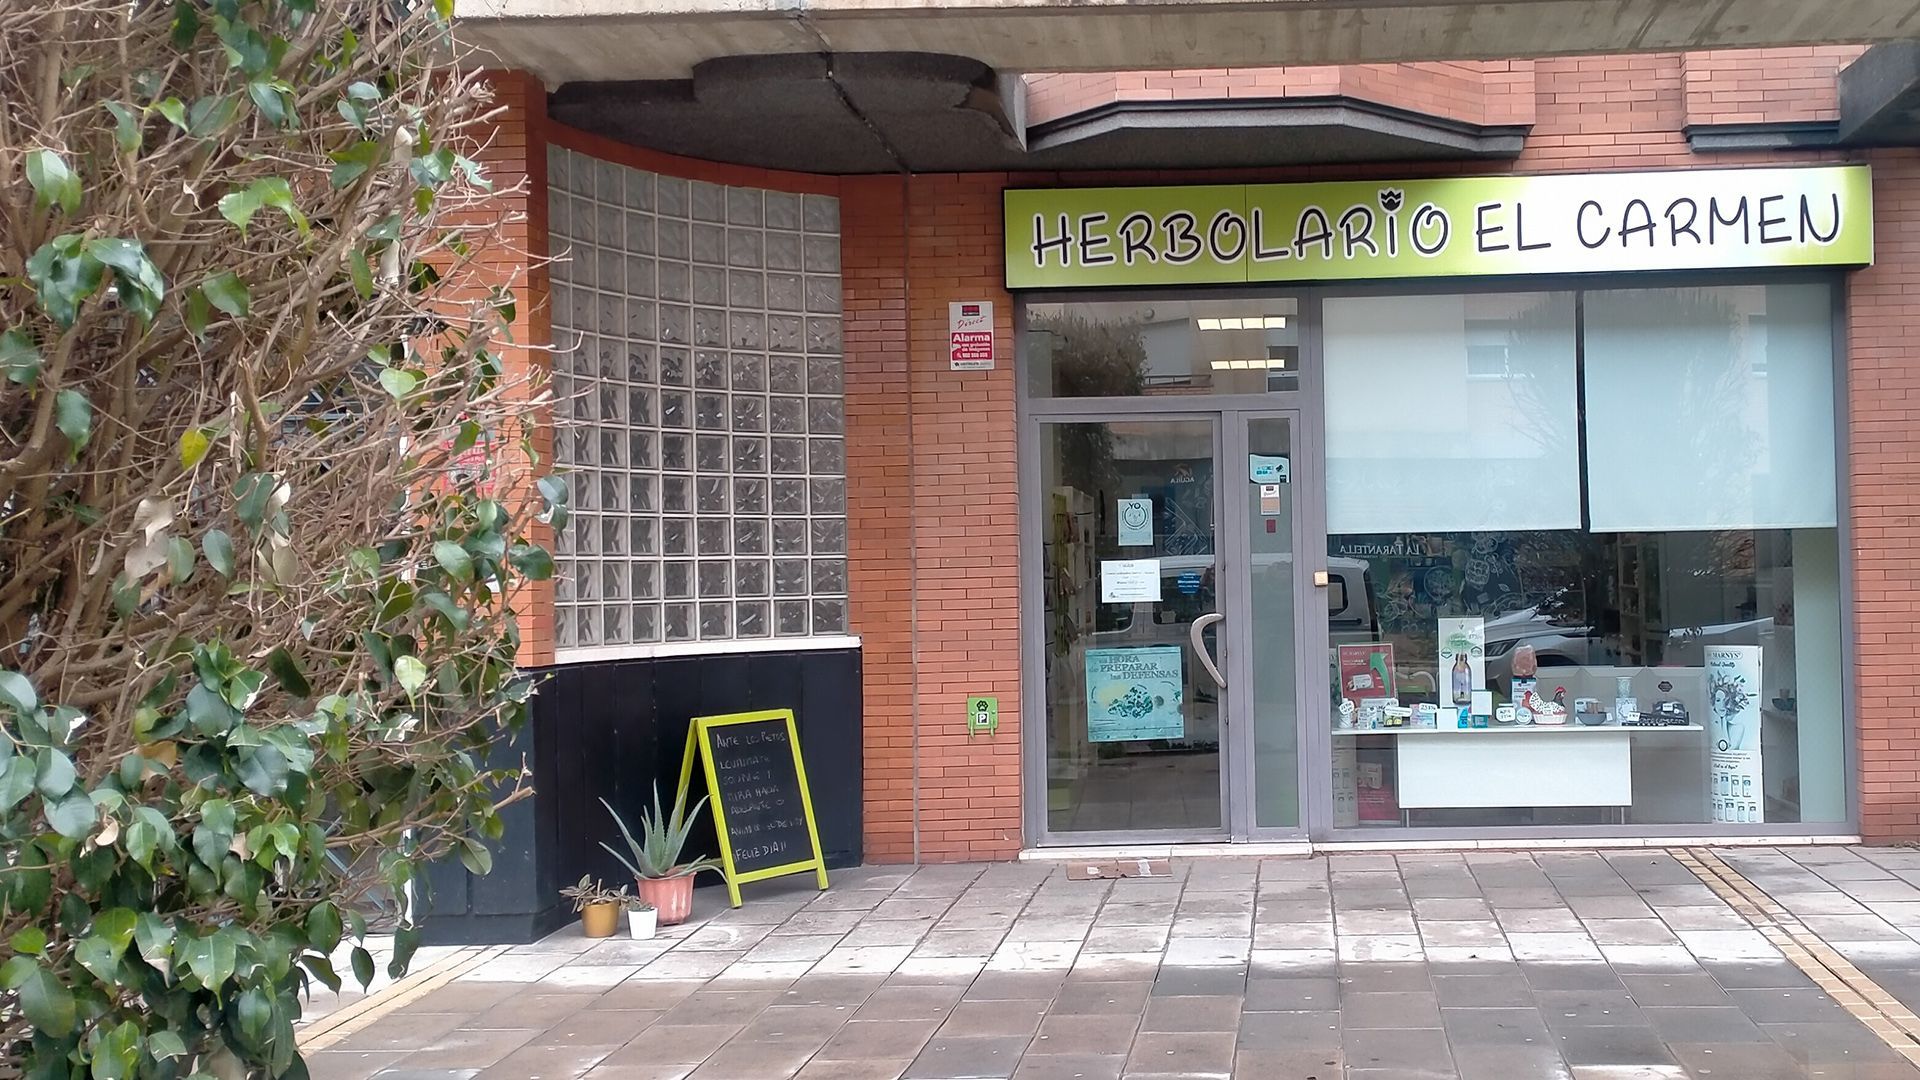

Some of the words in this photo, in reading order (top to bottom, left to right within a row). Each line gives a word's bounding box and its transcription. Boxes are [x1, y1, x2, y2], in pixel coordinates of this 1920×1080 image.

[1032, 189, 1448, 265] HERBOLARIO
[1477, 202, 1551, 252] EL
[1577, 193, 1840, 249] CARMEN
[953, 333, 990, 342] Alarma
[1109, 655, 1140, 663] HORA
[1100, 663, 1158, 672] PREPARAR
[1123, 669, 1178, 680] DEFENSAS
